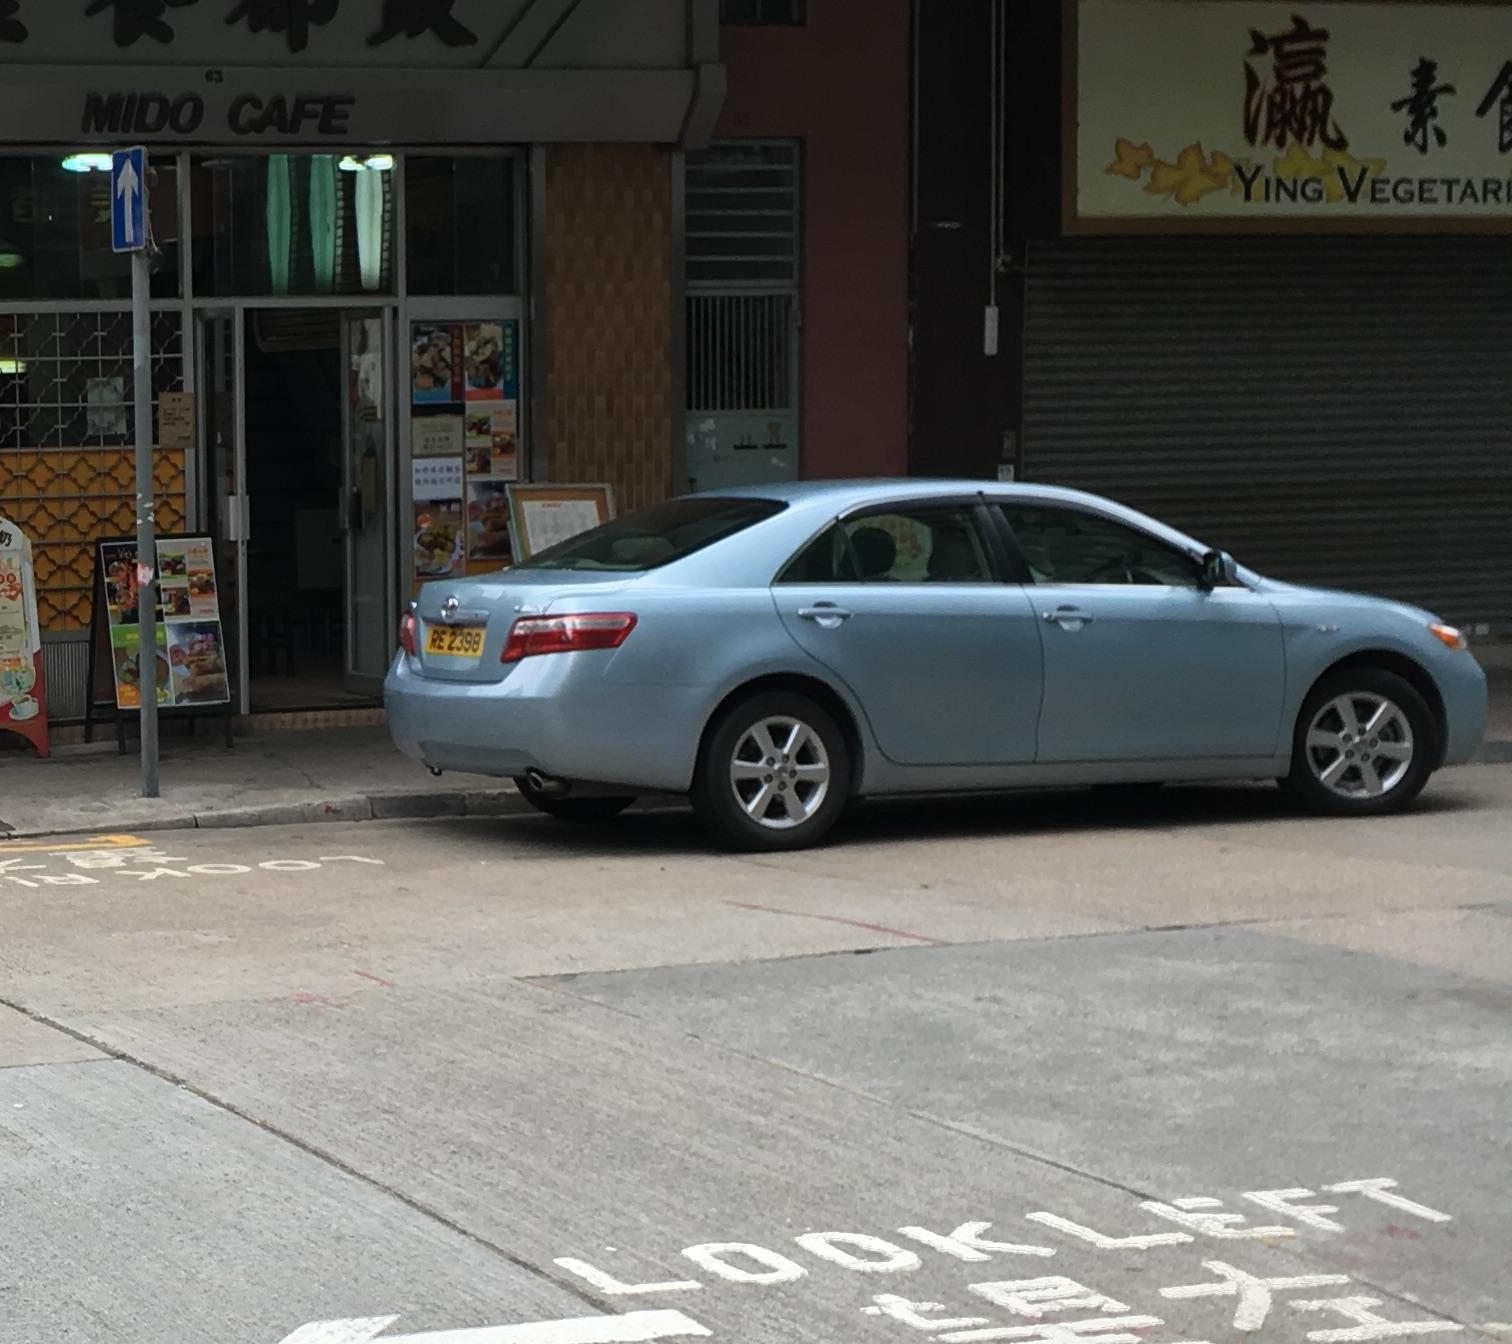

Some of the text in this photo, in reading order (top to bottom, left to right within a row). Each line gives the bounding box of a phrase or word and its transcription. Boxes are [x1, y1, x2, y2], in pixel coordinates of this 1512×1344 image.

[81, 92, 355, 135] MIDO CAFE
[1232, 163, 1324, 203] YING
[115, 855, 385, 882] LOOK
[553, 1175, 1453, 1297] LOOK LEFT
